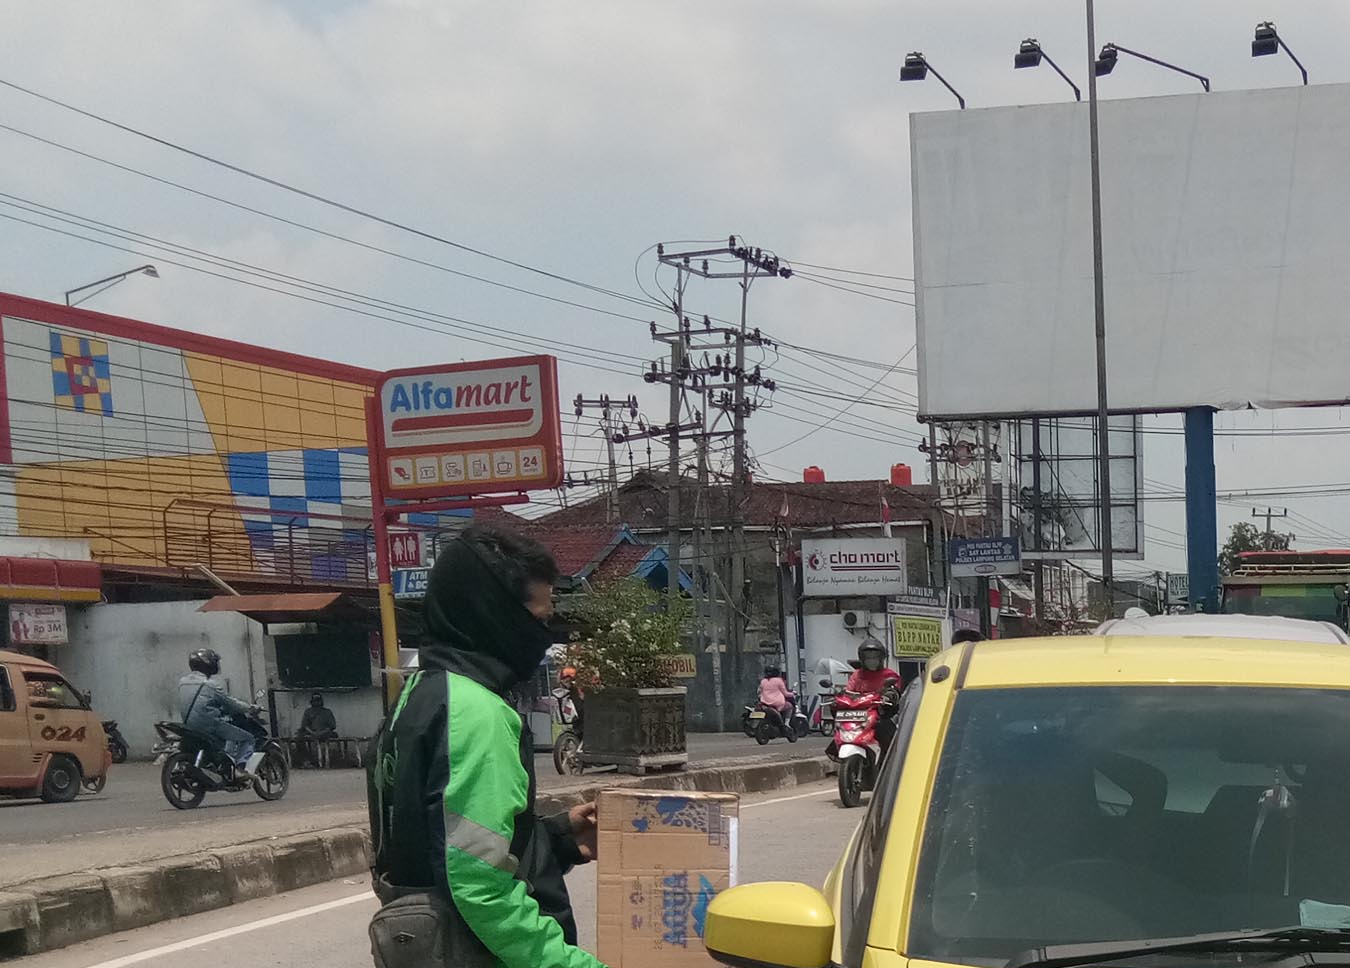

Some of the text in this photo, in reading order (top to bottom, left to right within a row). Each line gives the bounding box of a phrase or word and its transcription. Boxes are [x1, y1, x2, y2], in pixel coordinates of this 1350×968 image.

[390, 375, 532, 413] Alfamart
[523, 456, 538, 468] 24
[409, 571, 428, 581] ATM
[41, 726, 86, 742] 024
